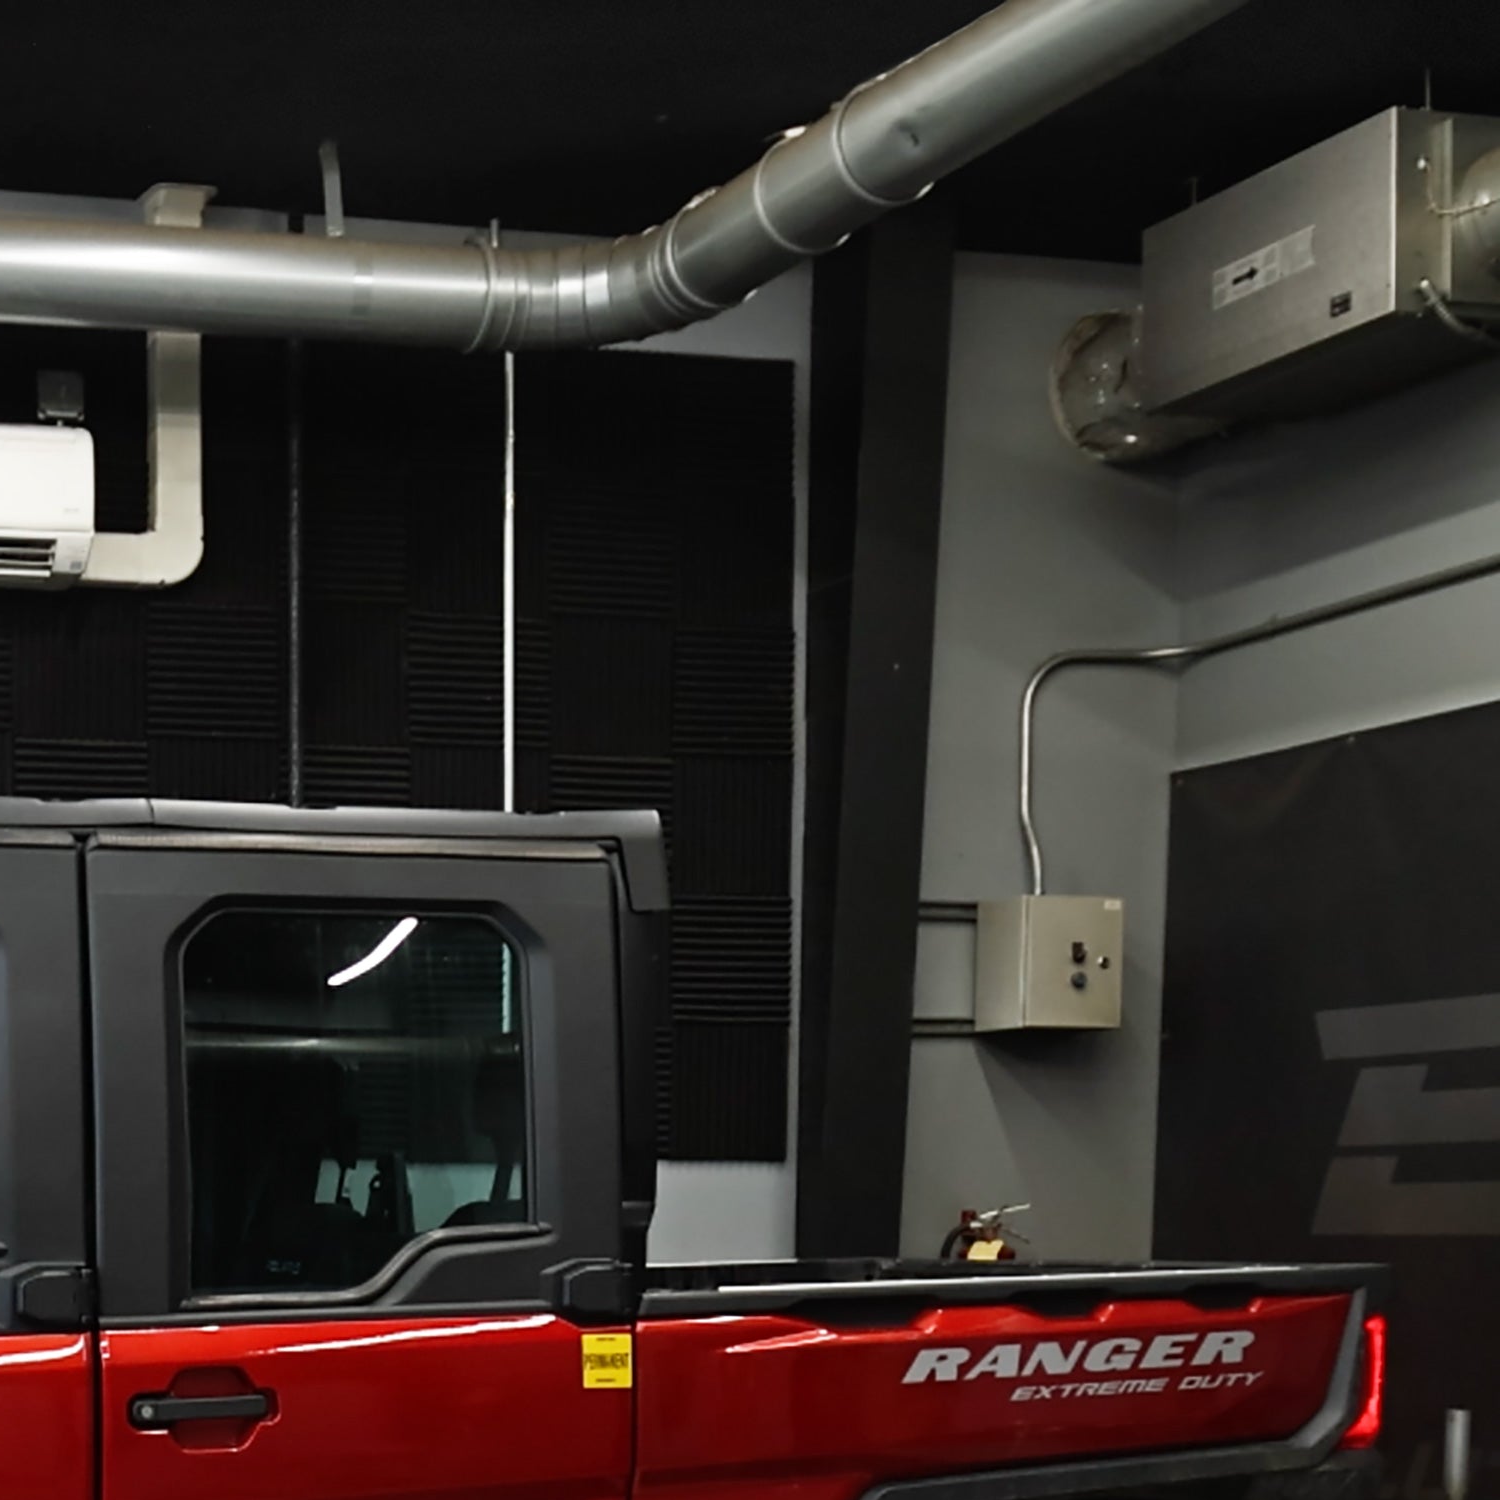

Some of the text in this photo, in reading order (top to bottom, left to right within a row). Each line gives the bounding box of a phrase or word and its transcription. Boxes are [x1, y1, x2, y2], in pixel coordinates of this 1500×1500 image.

[901, 1330, 1256, 1384] RANGER
[1009, 1371, 1265, 1402] EXTREME DUTY
